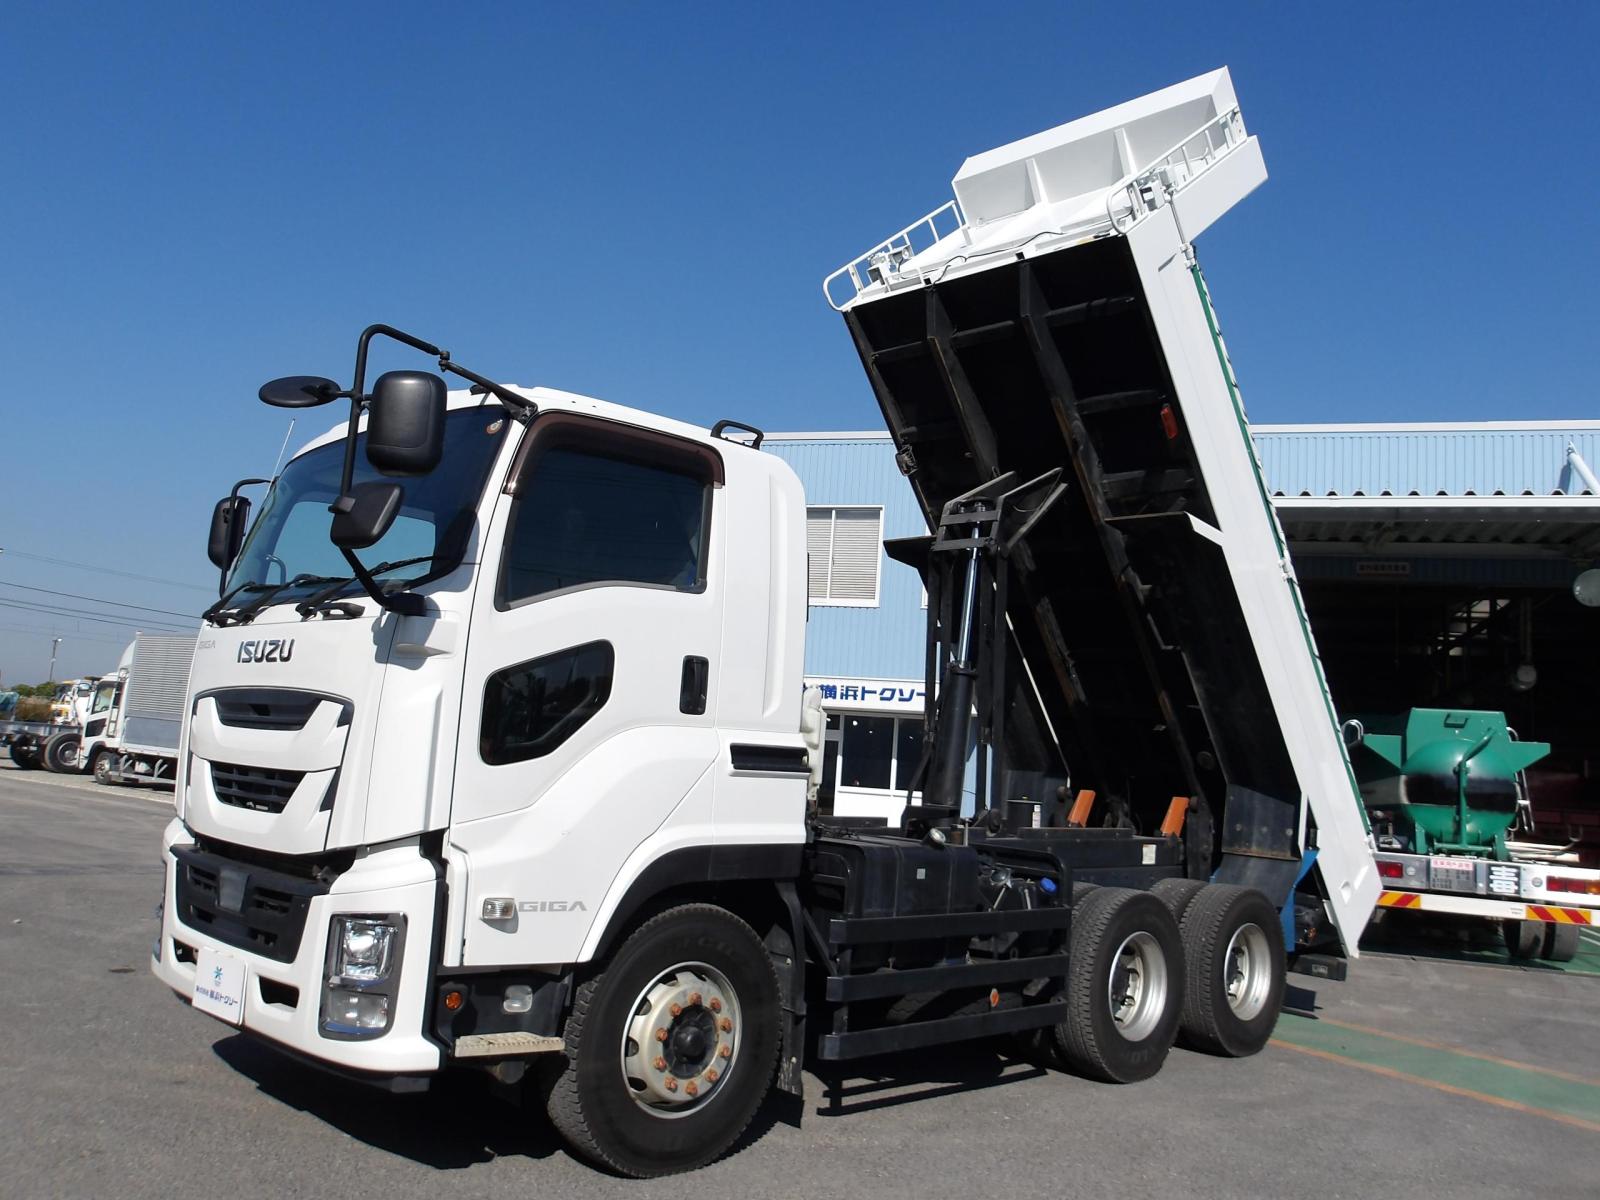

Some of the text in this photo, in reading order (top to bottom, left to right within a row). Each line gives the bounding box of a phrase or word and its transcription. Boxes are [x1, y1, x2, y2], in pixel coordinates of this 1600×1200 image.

[237, 638, 295, 663] ISUZU
[1489, 866, 1519, 893] 毒
[518, 901, 588, 912] GIGA
